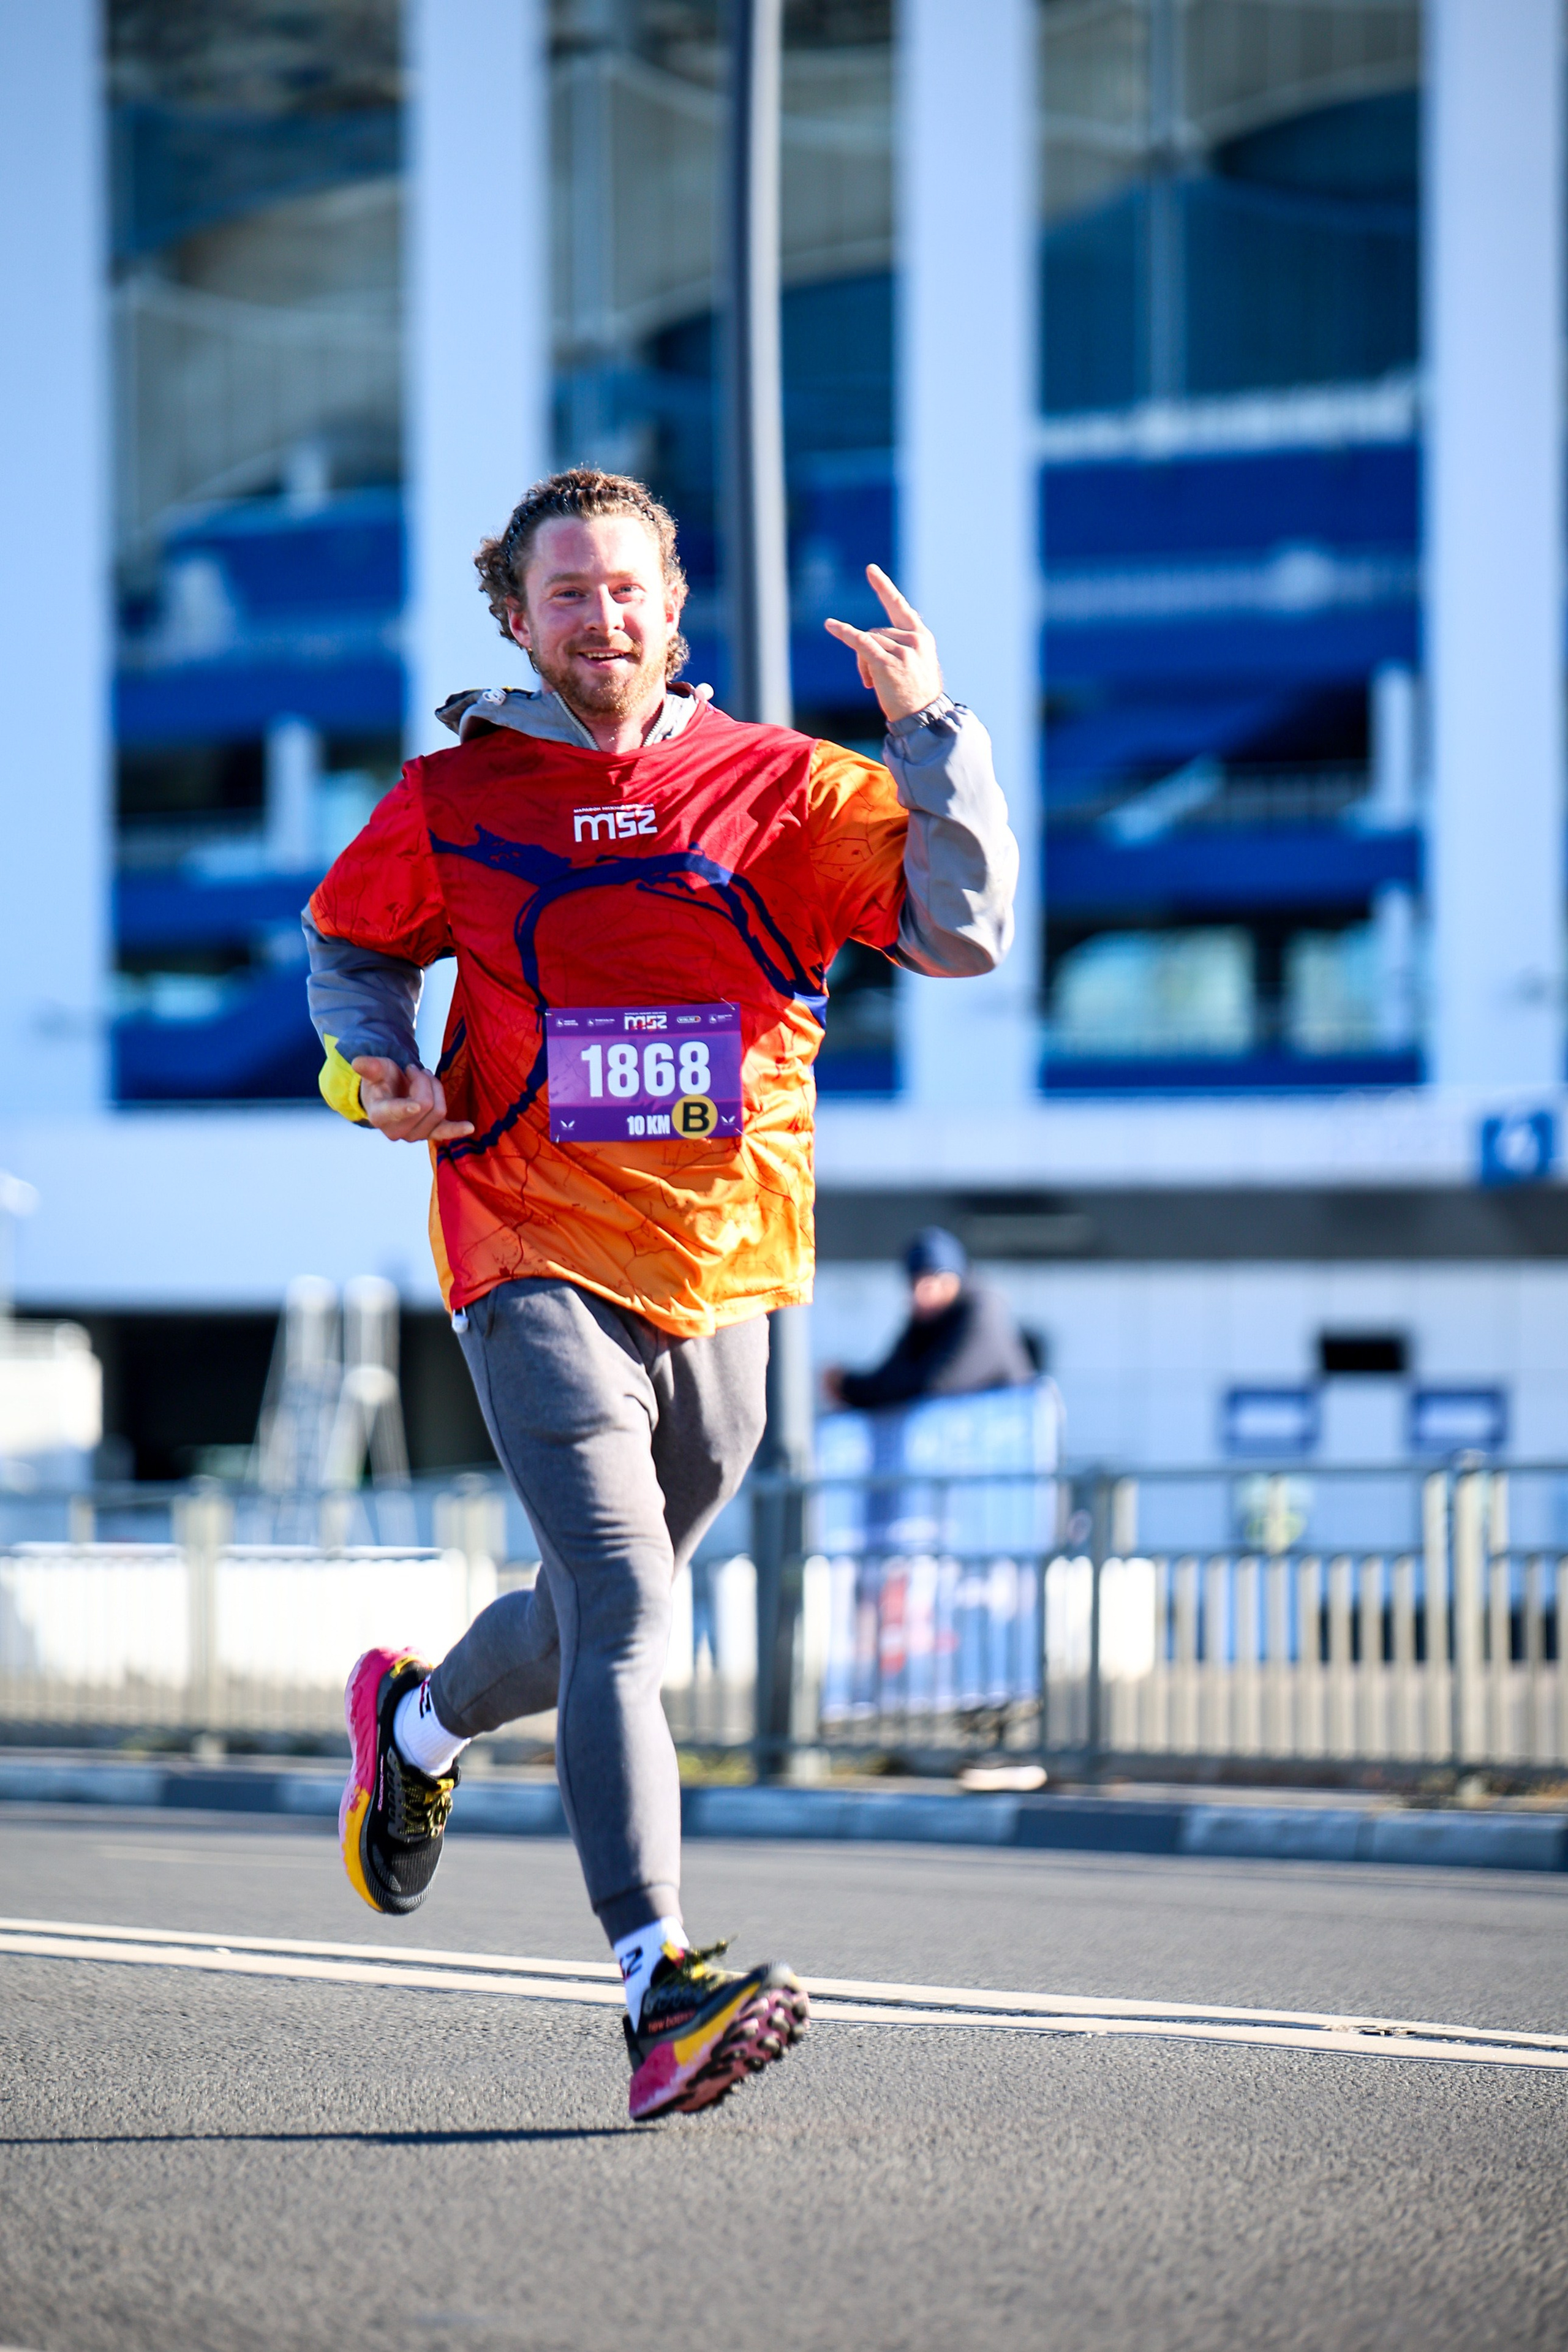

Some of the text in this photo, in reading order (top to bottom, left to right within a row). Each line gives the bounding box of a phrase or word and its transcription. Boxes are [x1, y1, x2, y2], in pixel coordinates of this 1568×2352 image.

[581, 1041, 711, 1098] 1868
[627, 1115, 645, 1135] 10
[683, 1102, 710, 1133] B
